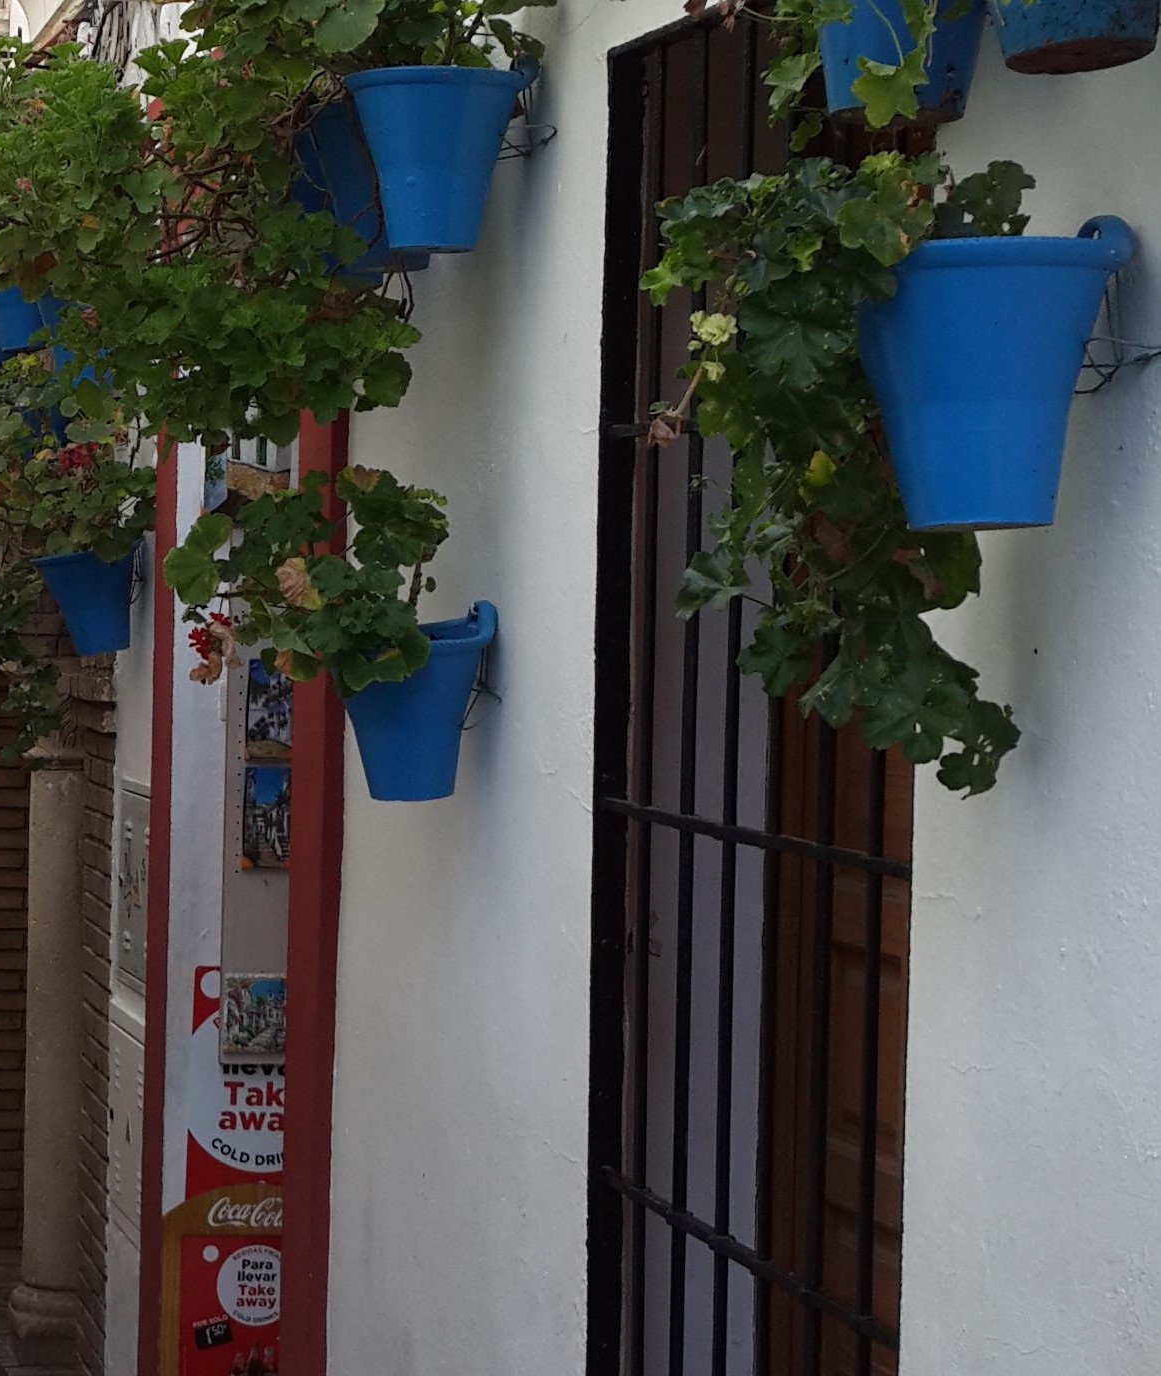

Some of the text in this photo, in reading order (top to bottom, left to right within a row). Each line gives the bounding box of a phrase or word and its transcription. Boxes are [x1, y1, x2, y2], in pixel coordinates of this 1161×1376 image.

[224, 1081, 285, 1107] Tak
[218, 1110, 285, 1132] awa
[211, 1137, 284, 1166] COLD DRI
[241, 1259, 273, 1270] Para
[237, 1270, 278, 1283] llevar
[238, 1284, 276, 1296] Take
[236, 1297, 277, 1310] away
